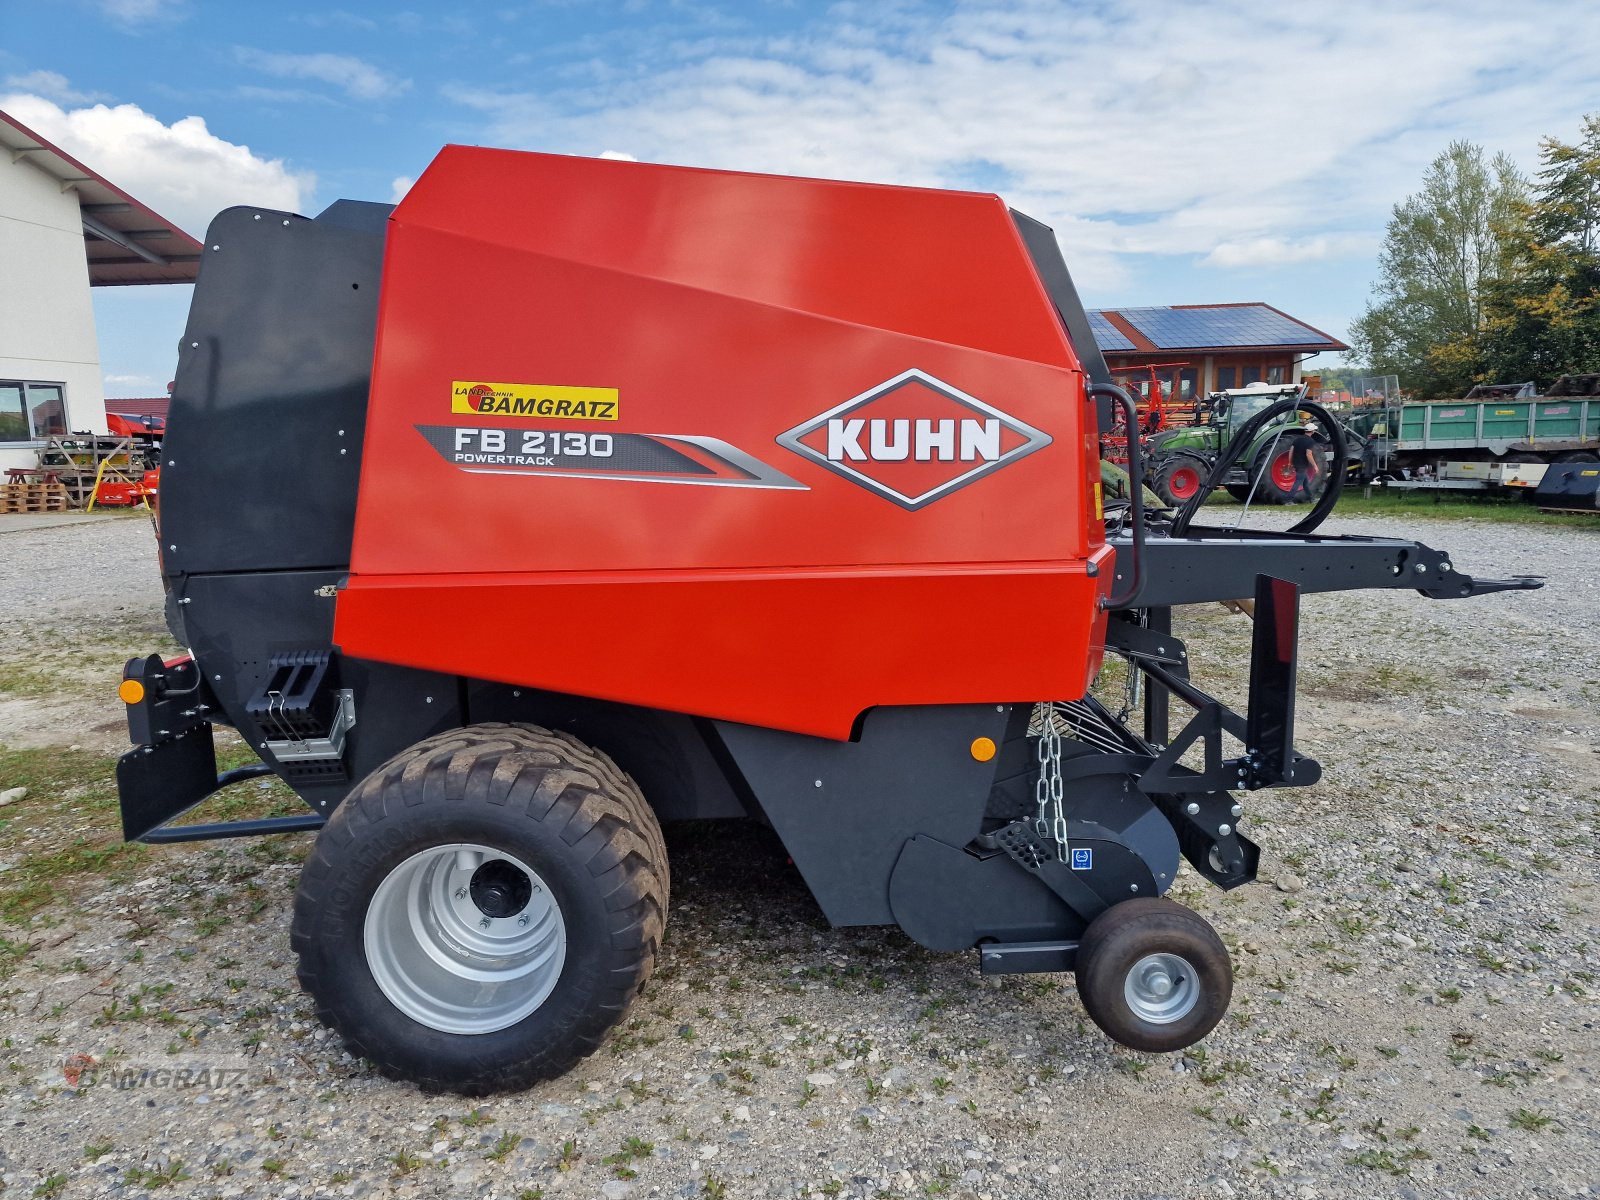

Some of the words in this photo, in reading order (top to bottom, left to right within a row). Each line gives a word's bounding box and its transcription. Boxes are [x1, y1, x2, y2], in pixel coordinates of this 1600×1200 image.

[479, 397, 615, 418] BAMGRATZ
[455, 428, 506, 453] FB
[521, 431, 614, 457] 2130
[827, 418, 1001, 462] KUHN
[455, 453, 555, 466] POWERTRACK
